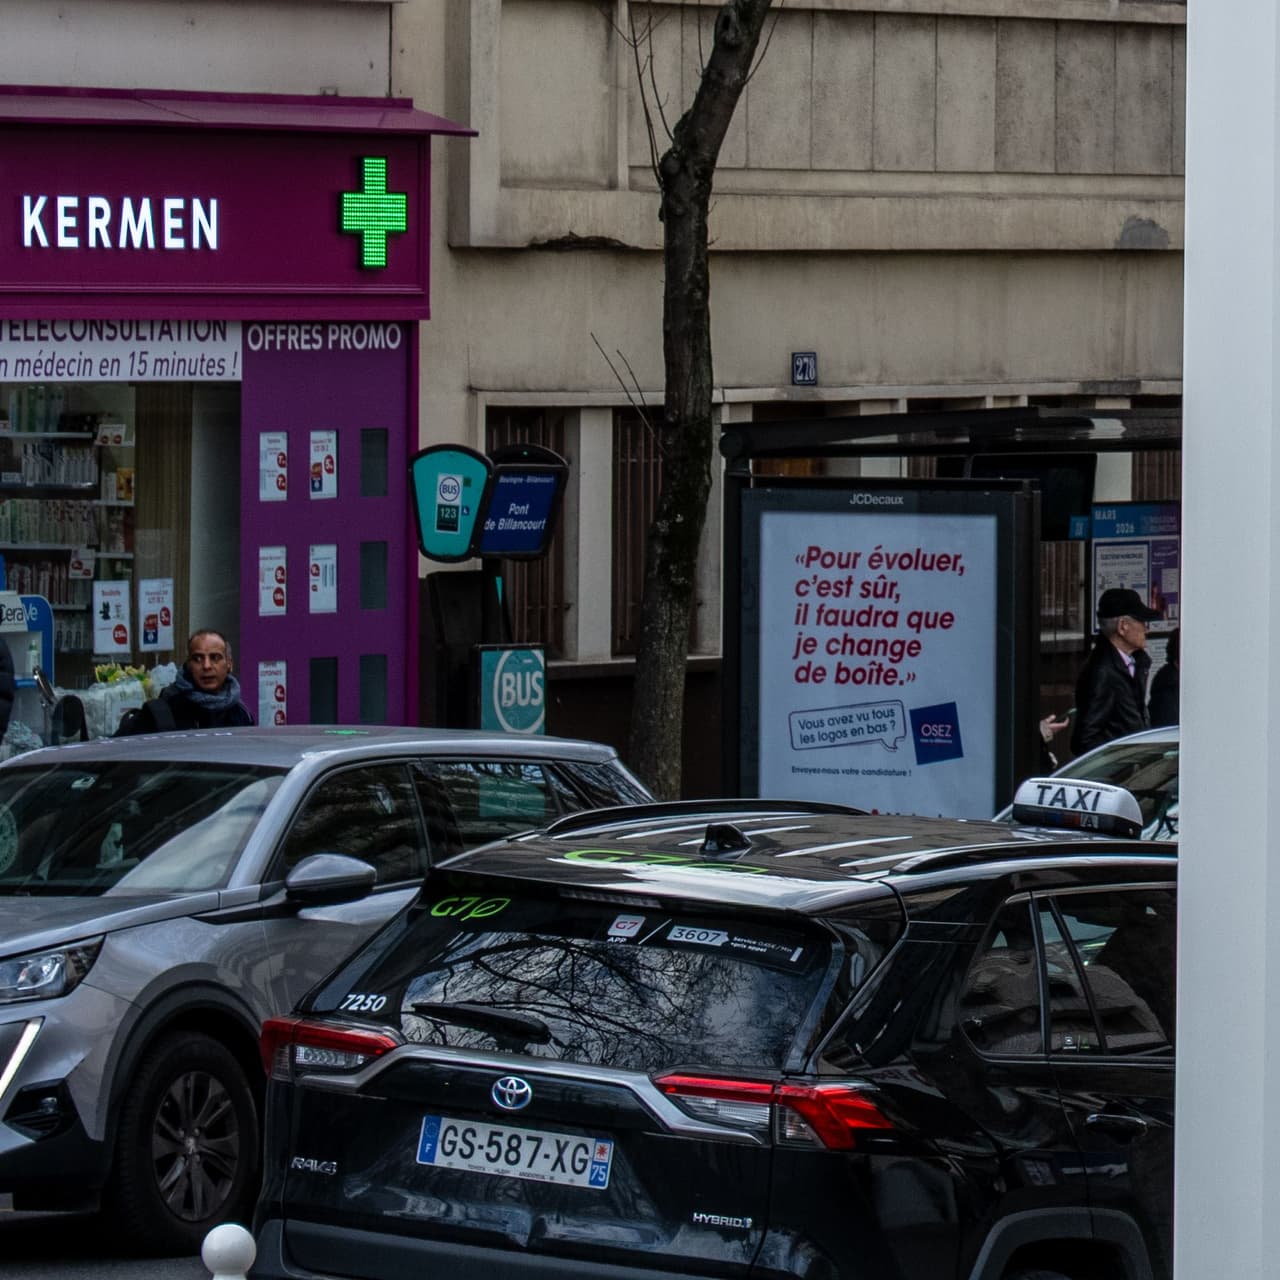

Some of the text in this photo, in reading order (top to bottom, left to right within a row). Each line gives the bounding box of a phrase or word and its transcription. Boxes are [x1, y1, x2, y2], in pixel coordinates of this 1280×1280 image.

[22, 195, 218, 250] KERMEN
[248, 324, 402, 351] OFFRES PROMO
[14, 350, 93, 377] médecin
[99, 357, 120, 377] en
[128, 351, 148, 377] 15
[153, 351, 226, 377] minutes
[232, 351, 238, 377] !
[796, 357, 816, 380] 278
[442, 484, 457, 495] BUS
[850, 493, 903, 505] JCDecaux
[440, 508, 457, 519] 123
[508, 503, 530, 515] Pont
[1094, 510, 1116, 521] MARS
[484, 518, 546, 530] de Billancourt
[868, 545, 965, 576] évoluer,
[859, 574, 901, 603] sûr,
[794, 603, 954, 634] il faudra que
[792, 632, 922, 664] je change
[794, 661, 827, 684] de
[501, 671, 543, 707] BUS
[798, 708, 895, 730] Vous avez vu tous
[921, 723, 952, 737] OSEZ
[800, 720, 896, 744] les logos en bas ?
[1037, 784, 1102, 811] TAXI
[430, 897, 481, 917] G7
[615, 920, 639, 930] G7
[673, 928, 721, 942] 3607
[339, 993, 387, 1012] 7250
[440, 1124, 590, 1175] GS-587-XG
[591, 1165, 607, 1182] 75
[693, 1212, 742, 1228] HYBRID
